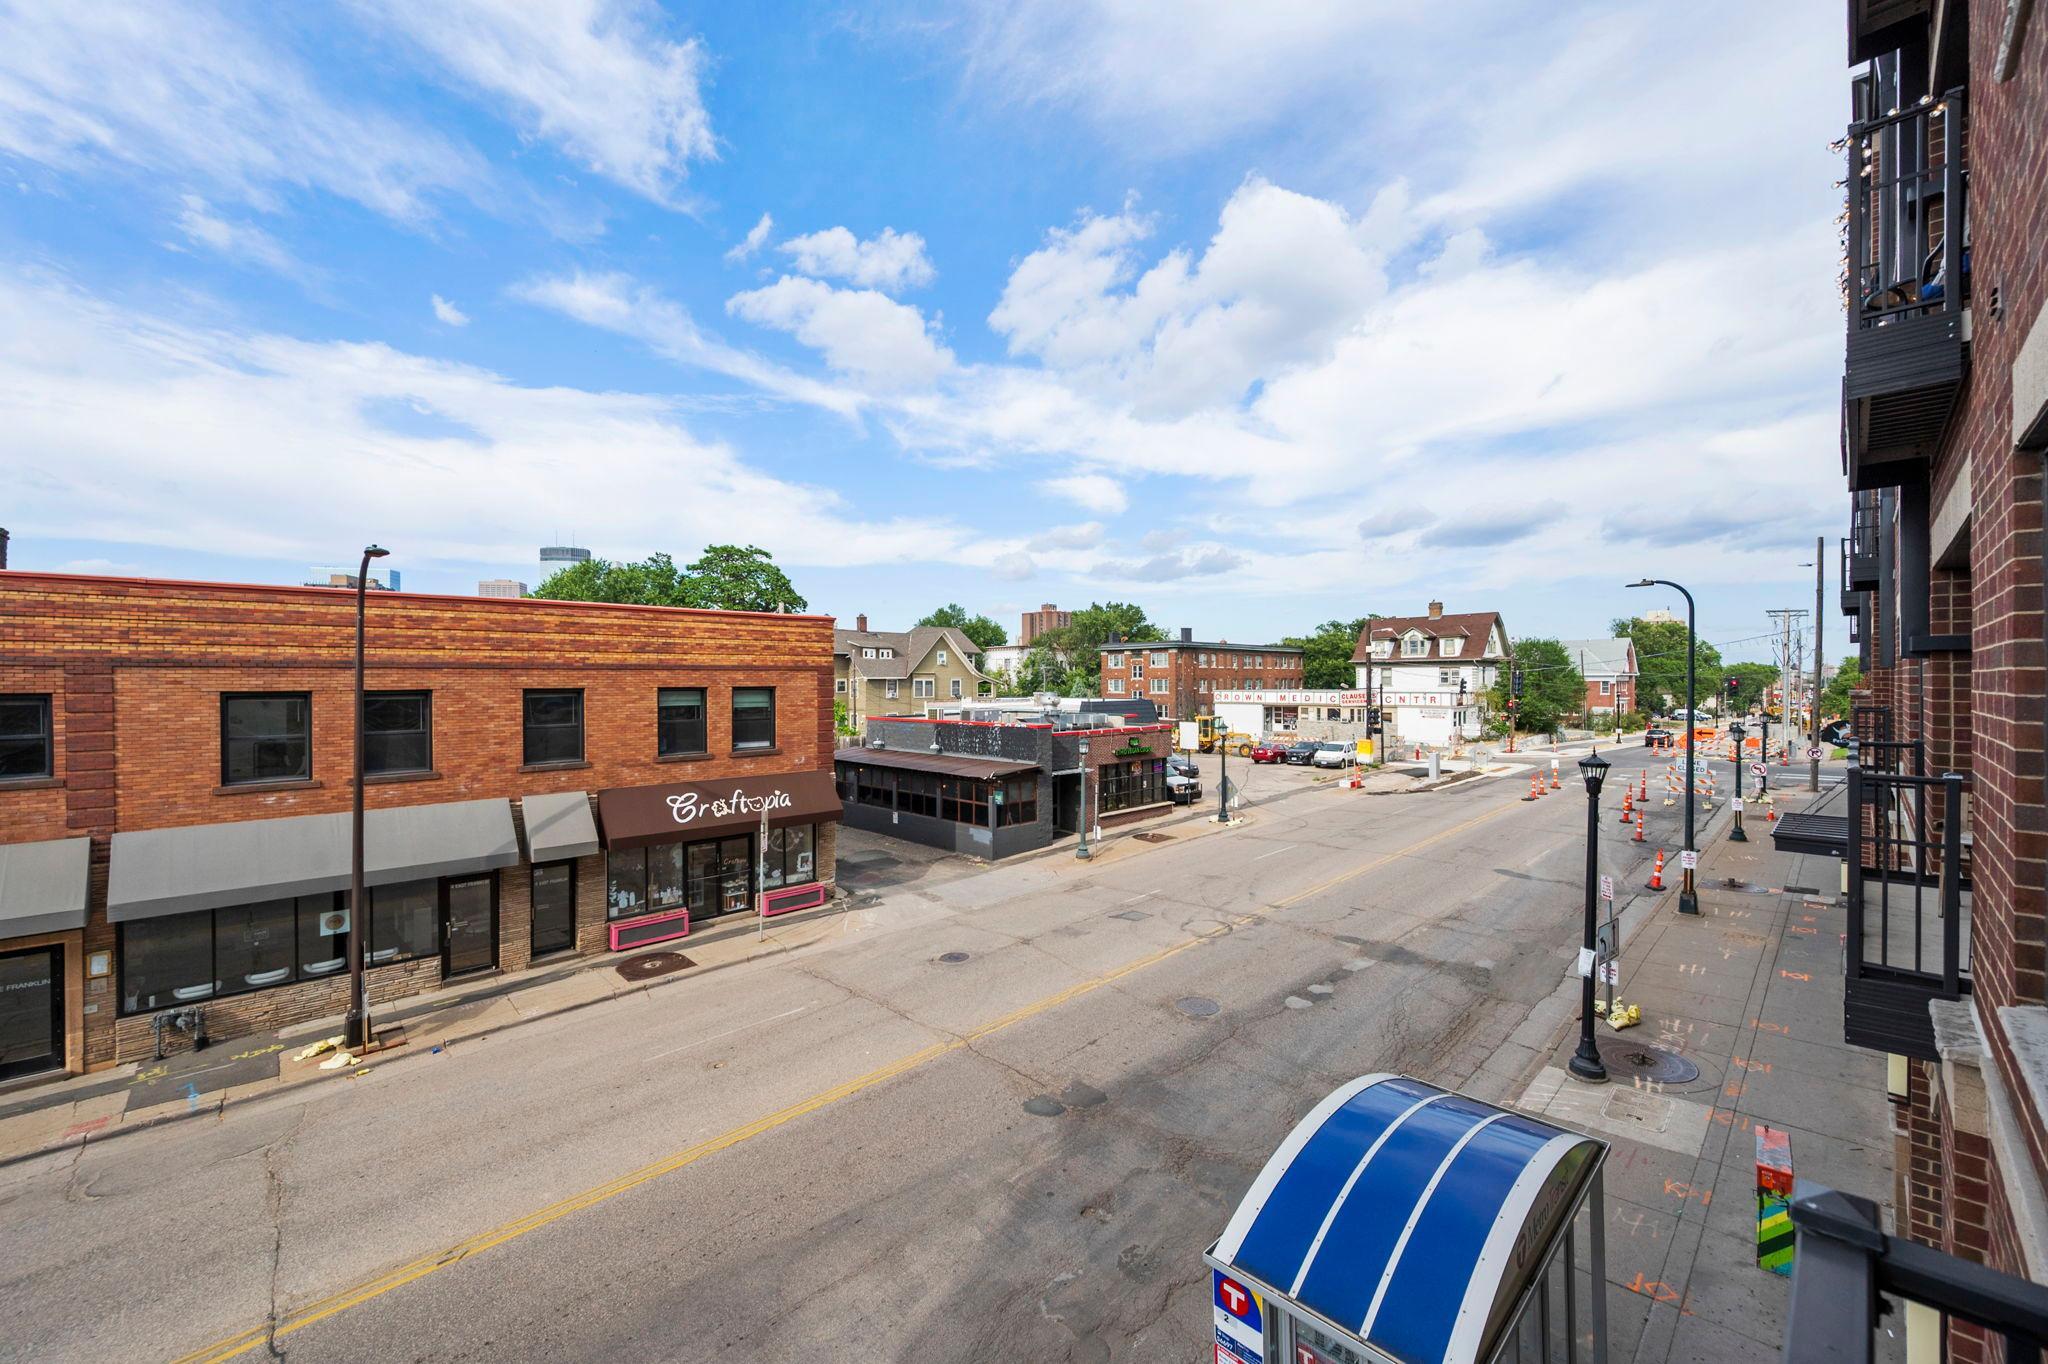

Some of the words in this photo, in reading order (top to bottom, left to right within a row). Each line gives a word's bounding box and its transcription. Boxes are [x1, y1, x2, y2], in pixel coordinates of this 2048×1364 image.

[1279, 695, 1336, 703] MEDIC
[1384, 695, 1437, 704] CNTR
[666, 789, 792, 823] Craftopia
[6, 978, 50, 990] FRANKLIN
[1223, 1282, 1246, 1312] T
[1224, 1314, 1230, 1323] 2
